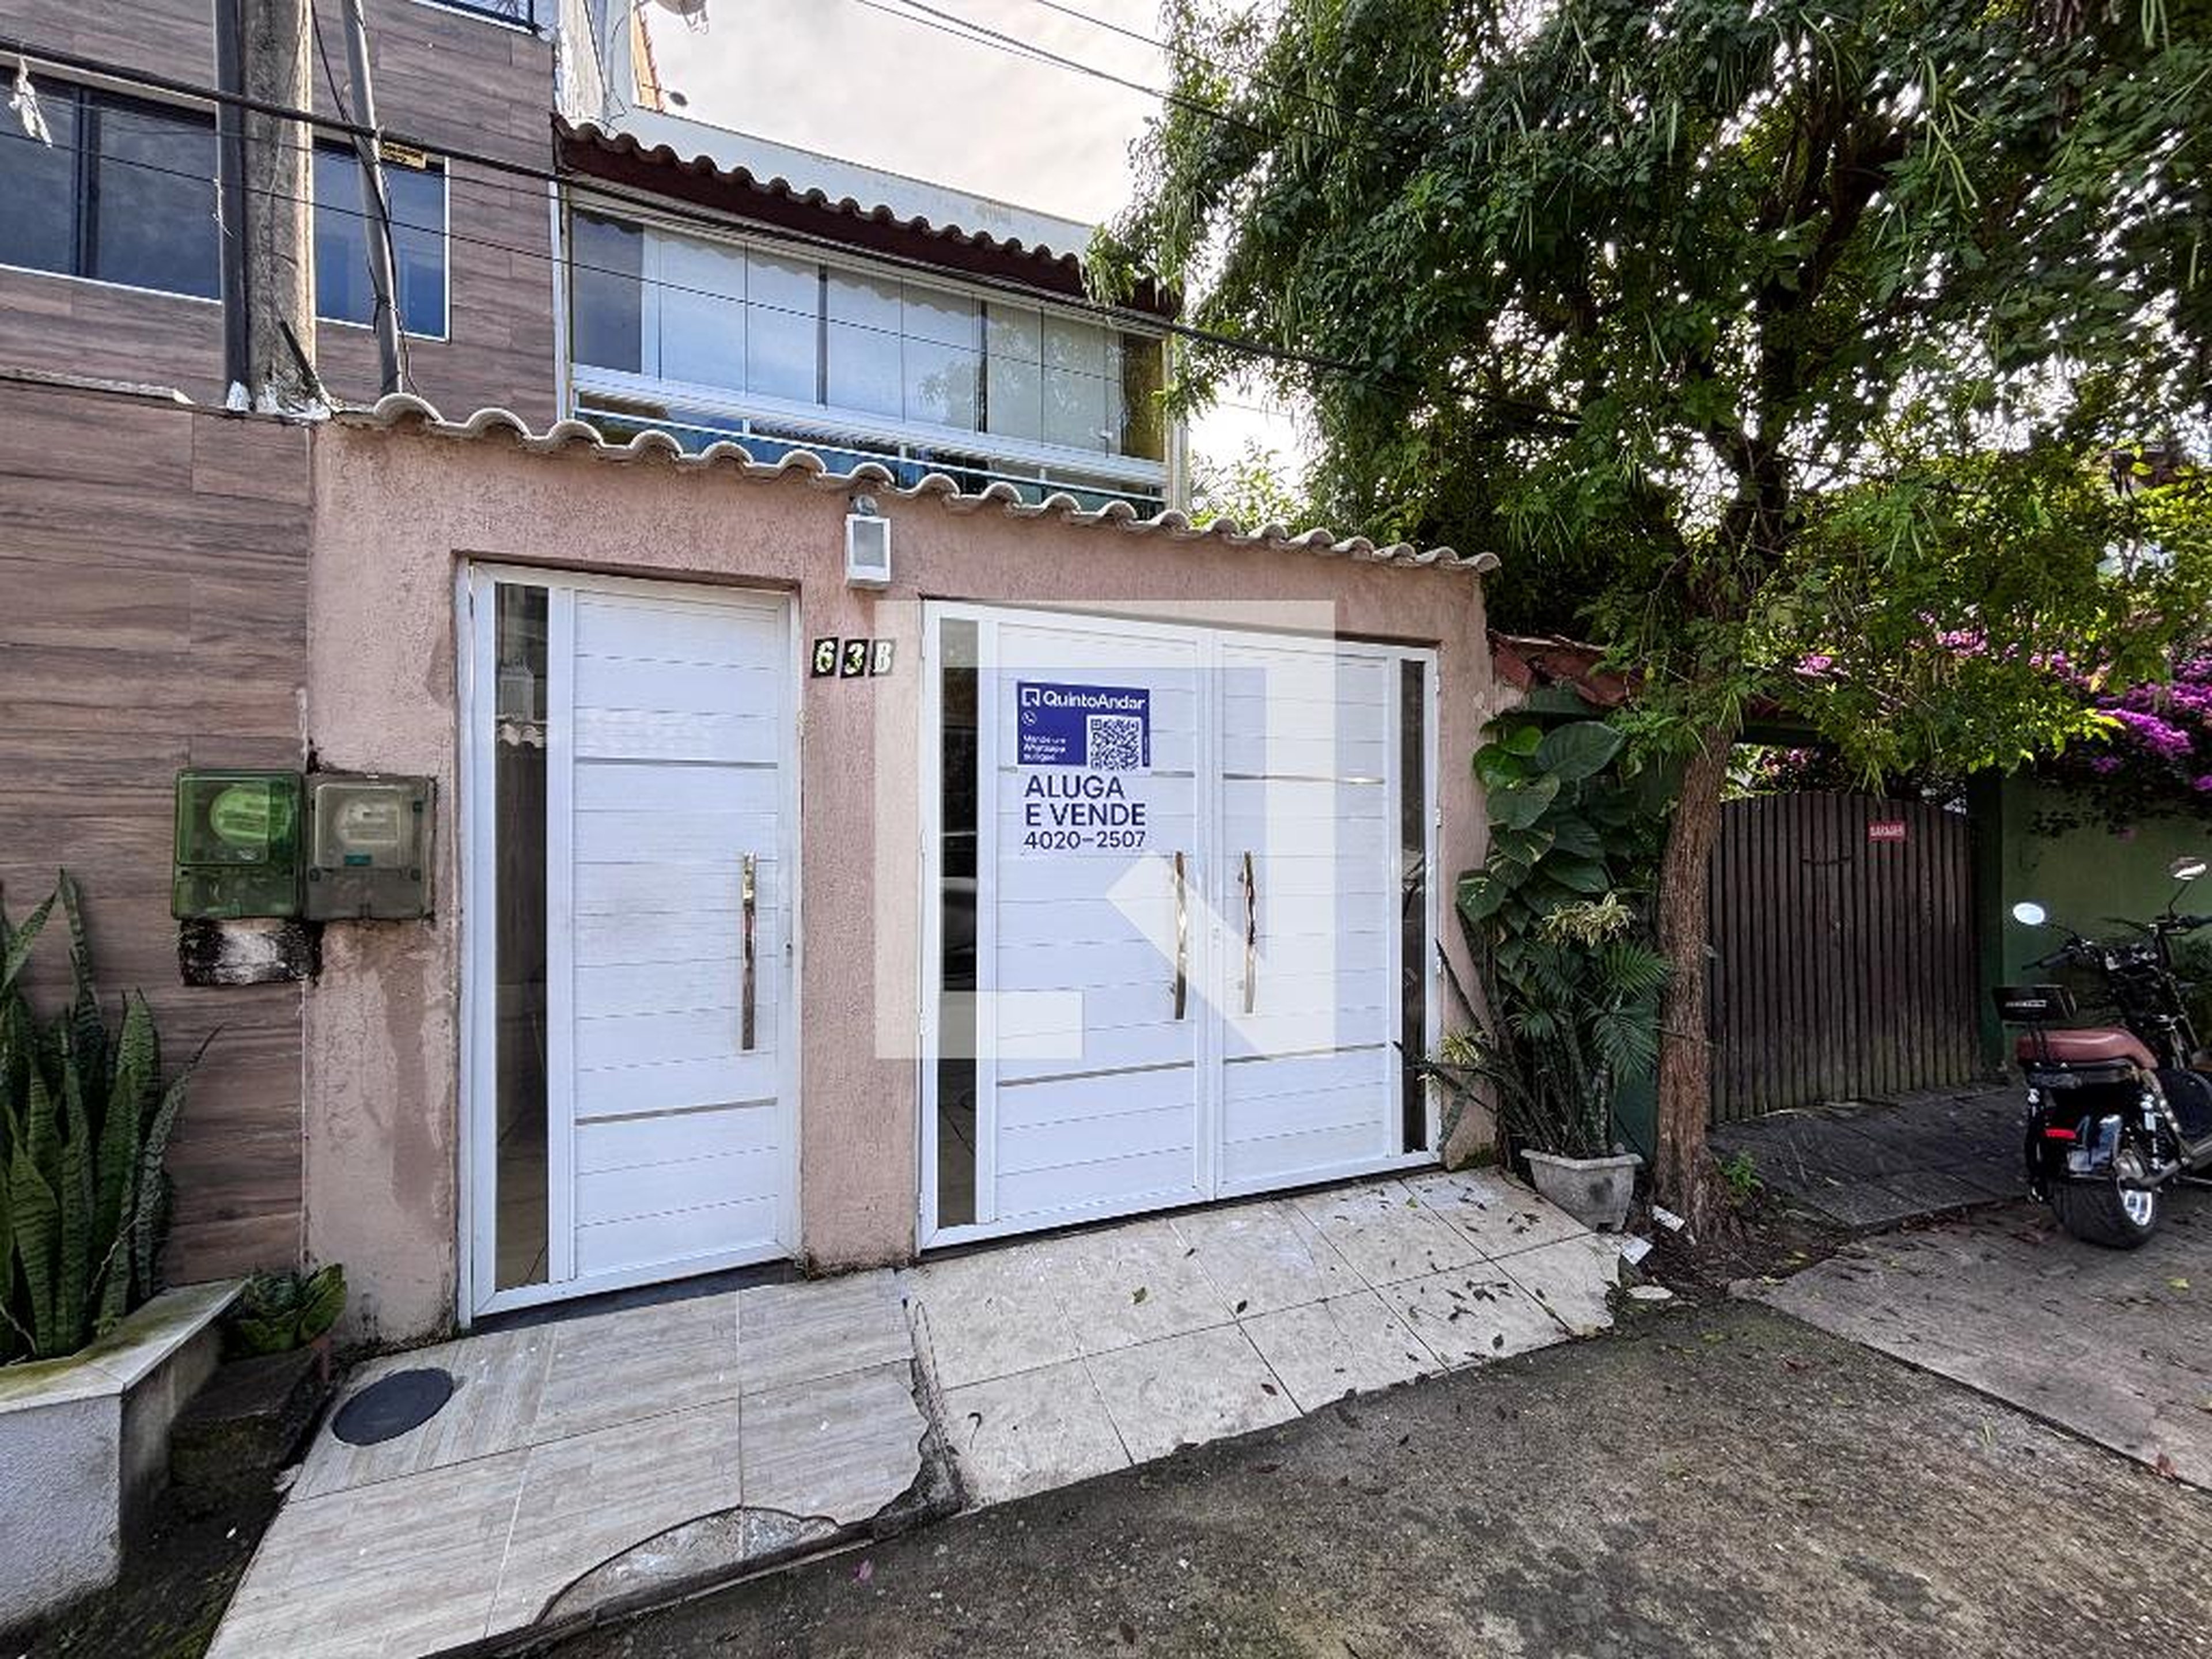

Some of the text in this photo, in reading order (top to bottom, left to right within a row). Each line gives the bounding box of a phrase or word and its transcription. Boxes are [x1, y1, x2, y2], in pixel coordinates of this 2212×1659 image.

[815, 640, 892, 675] 63B
[1043, 691, 1146, 710] QuintoAndar
[1024, 775, 1124, 799] ALUGA
[1026, 803, 1146, 826] E VENDE
[1023, 831, 1146, 850] 4020-2507
